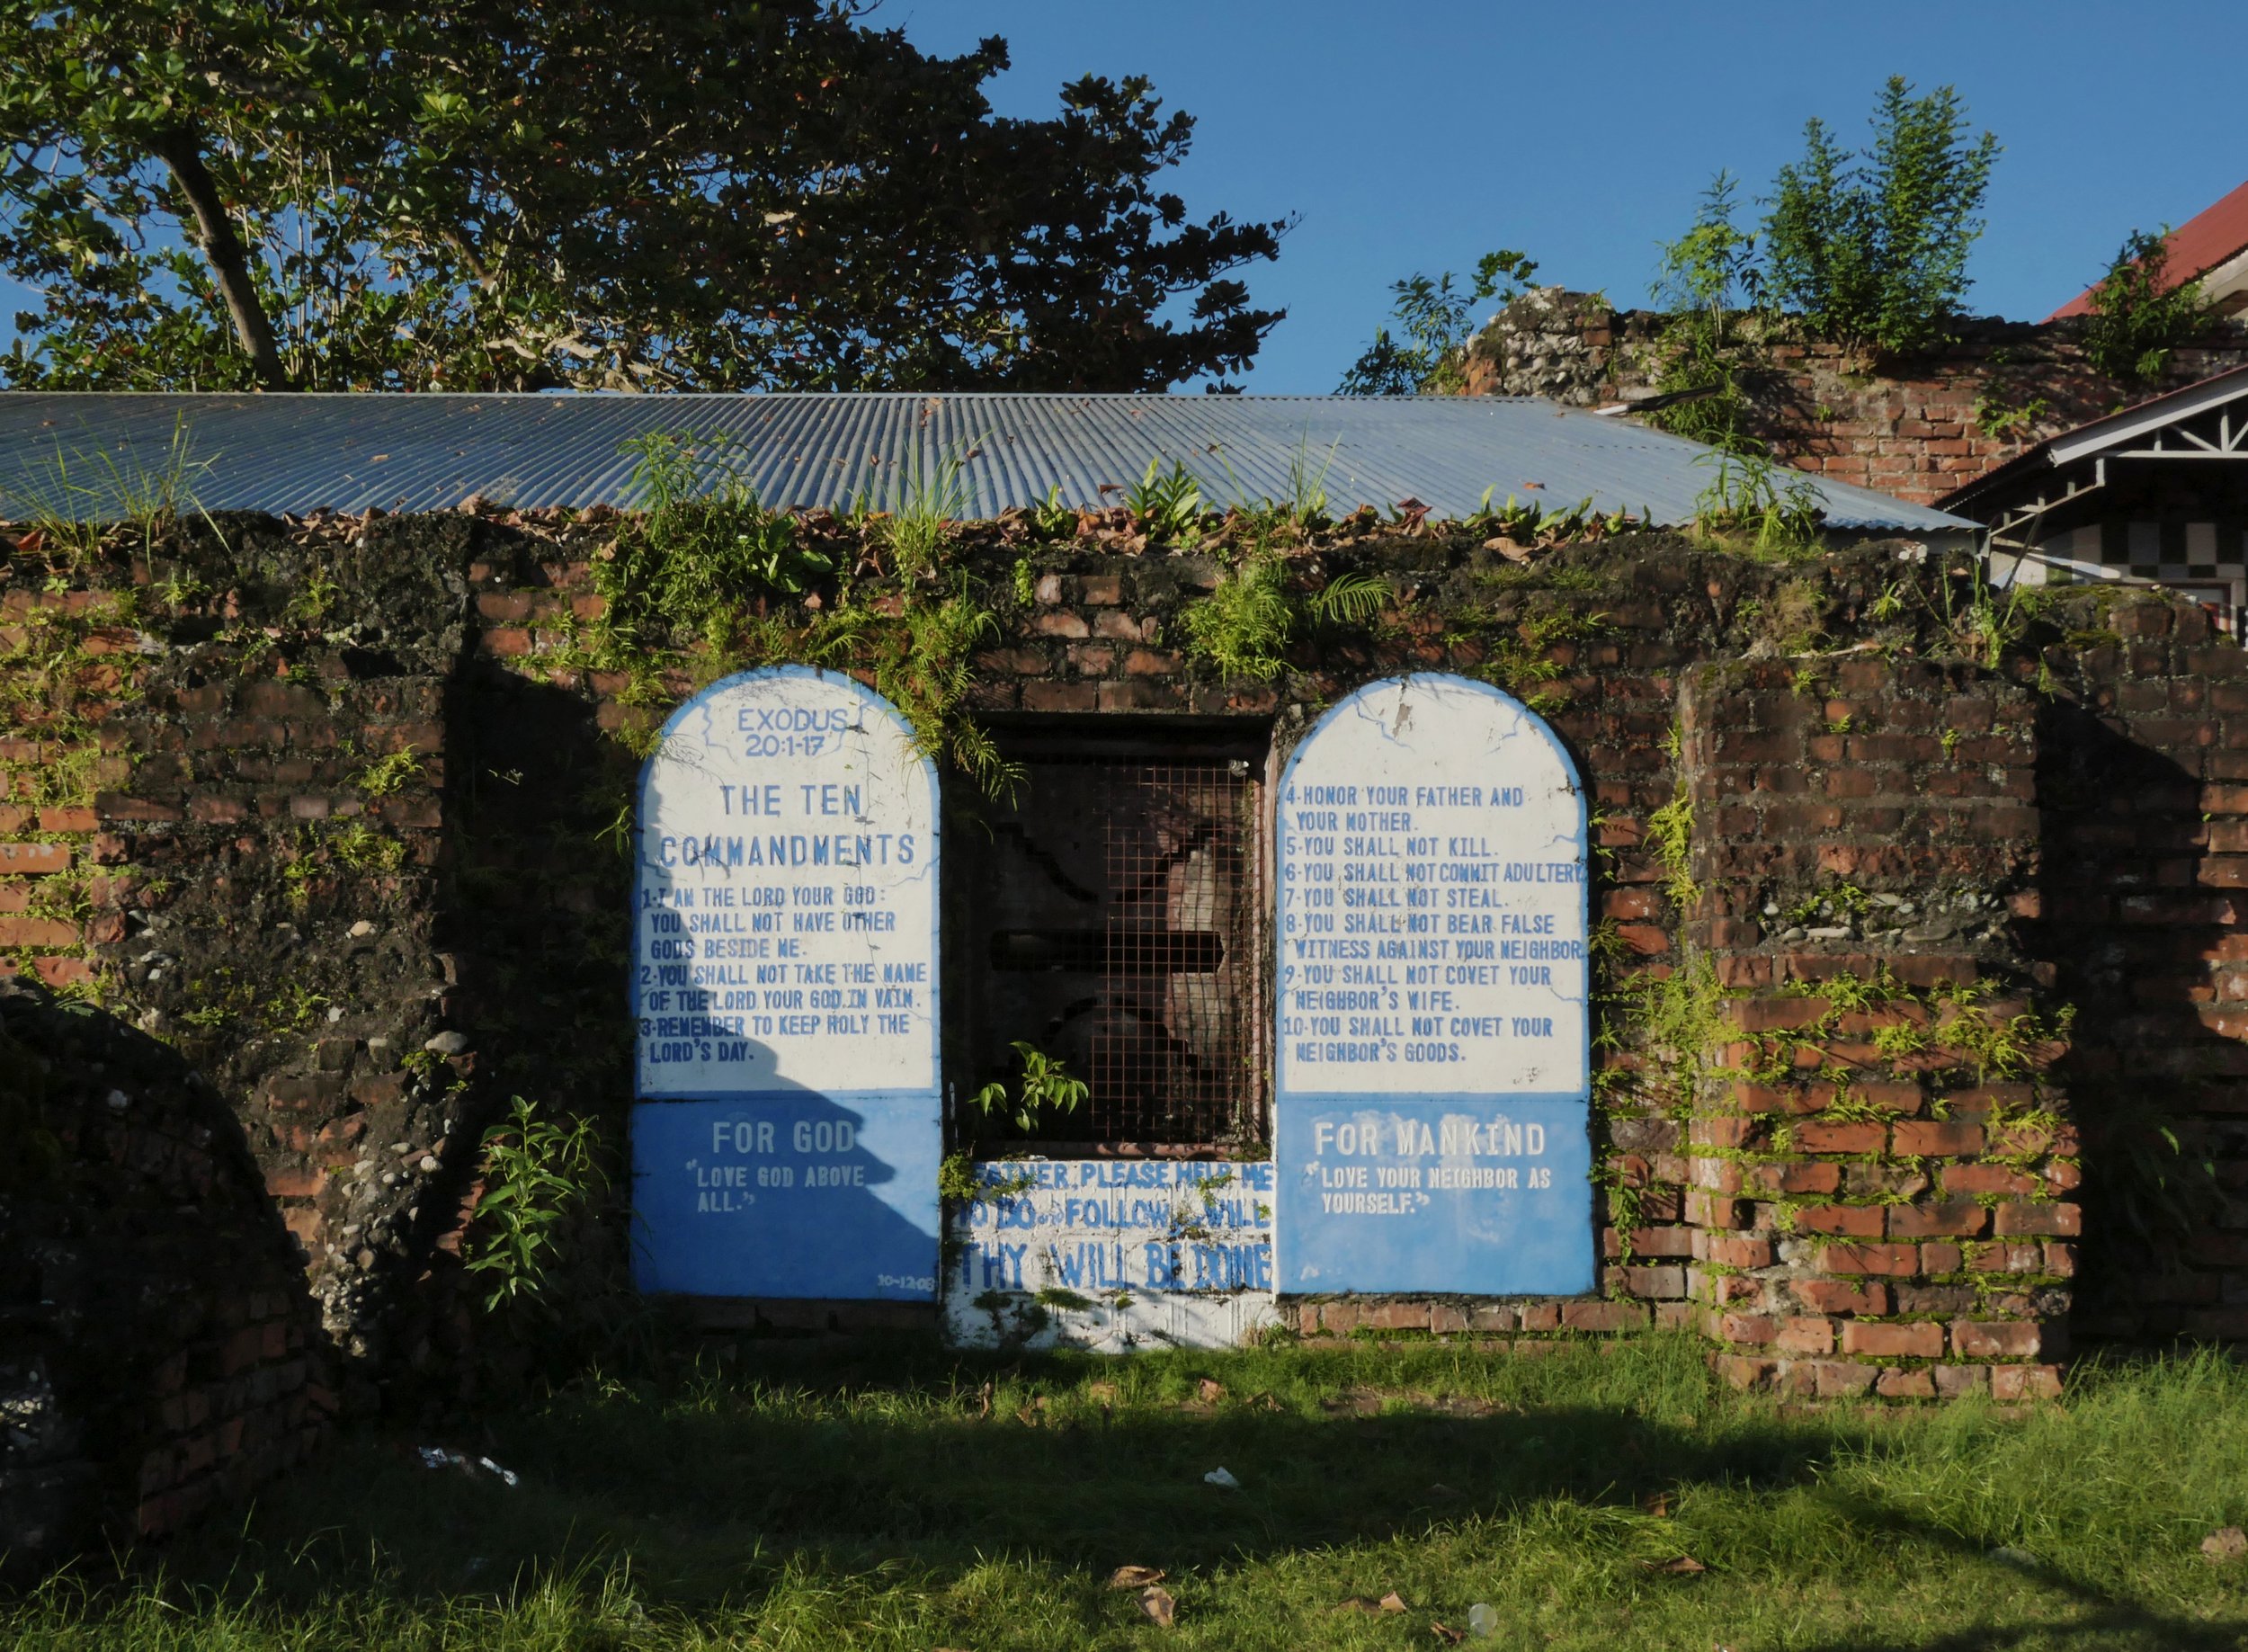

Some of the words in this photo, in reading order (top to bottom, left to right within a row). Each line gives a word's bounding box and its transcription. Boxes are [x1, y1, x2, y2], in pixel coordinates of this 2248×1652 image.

[738, 708, 848, 731] EXODUS
[745, 735, 825, 756] 20:1-17
[721, 785, 781, 816] THE
[800, 784, 861, 816] TEN
[1367, 786, 1407, 806] YOUR
[1416, 786, 1482, 808] FATHER
[1490, 787, 1524, 808] AND
[1297, 812, 1338, 831] YOUR
[1346, 812, 1418, 832] MOTHER.
[660, 834, 914, 867] COMMANDMENTS
[1343, 836, 1399, 856] SHALL
[1406, 837, 1439, 856] NOT
[1344, 862, 1399, 882] SHALL
[1406, 862, 1435, 882] NOT
[1440, 862, 1499, 882] COMMIT
[674, 888, 694, 907] AM
[702, 888, 735, 906] THE
[743, 887, 784, 906] LORD
[792, 887, 834, 906] YOUR
[1343, 888, 1400, 908] SHALL
[1407, 888, 1439, 908] NOT
[651, 914, 680, 933] YOU
[689, 914, 745, 933] SHALL
[753, 913, 783, 932] NOT
[794, 913, 834, 931] HAVE
[843, 911, 895, 931] OTHER
[1345, 914, 1400, 933] SHALL
[1407, 914, 1441, 933] NOT
[1448, 914, 1494, 934] BEAR
[1502, 915, 1554, 934] FALSE
[651, 940, 695, 960] GODS
[705, 939, 770, 959] BESIDE
[778, 938, 807, 958] ME.
[1295, 941, 1370, 960] WITNESS
[1377, 940, 1449, 960] AGAINST
[1456, 940, 1494, 960] YOUR
[694, 965, 747, 985] SHALL
[757, 964, 788, 984] NOT
[795, 964, 836, 985] TAKE
[843, 964, 874, 983] THE
[884, 963, 926, 983] NAME
[1343, 965, 1398, 985] SHALL
[1406, 965, 1439, 985] NOT
[1446, 965, 1500, 986] COVET
[1510, 965, 1551, 986] YOUR
[649, 992, 669, 1011] OF
[676, 991, 708, 1011] THE
[713, 991, 756, 1010] LORD
[763, 990, 802, 1010] YOUR
[810, 990, 842, 1010] GOD
[850, 989, 867, 1009] IN
[1408, 991, 1459, 1012] WIFE.
[753, 1016, 772, 1036] TO
[779, 1015, 820, 1035] KEEP
[827, 1014, 869, 1034] HOLY
[878, 1014, 909, 1034] THE
[1349, 1016, 1405, 1038] SHALL
[1412, 1016, 1443, 1037] NOT
[1450, 1017, 1503, 1038] COVET
[1512, 1017, 1553, 1038] YOUR
[650, 1040, 711, 1064] LORD'S
[718, 1042, 754, 1062] DAY.
[1405, 1043, 1466, 1063] GOODS.
[713, 1121, 774, 1154] FOR
[794, 1121, 853, 1154] GOD
[1315, 1122, 1378, 1156] FOR
[1397, 1123, 1545, 1156] MANKIND
[757, 1167, 793, 1187] GOD
[805, 1165, 864, 1186] ABOVE
[1081, 1162, 1170, 1190] PLEASE
[1176, 1162, 1231, 1191] HELP
[1242, 1163, 1273, 1192] ME
[1377, 1168, 1421, 1189] YOUR
[1428, 1168, 1518, 1189] NEIGHBOR
[1528, 1168, 1551, 1189] AS
[995, 1197, 1035, 1229] DO
[1066, 1198, 1170, 1229] FOLLOW
[961, 1242, 1027, 1290] THY
[1051, 1242, 1137, 1290] WILL
[1144, 1242, 1187, 1289] BE
[1190, 1243, 1271, 1290] DONE
